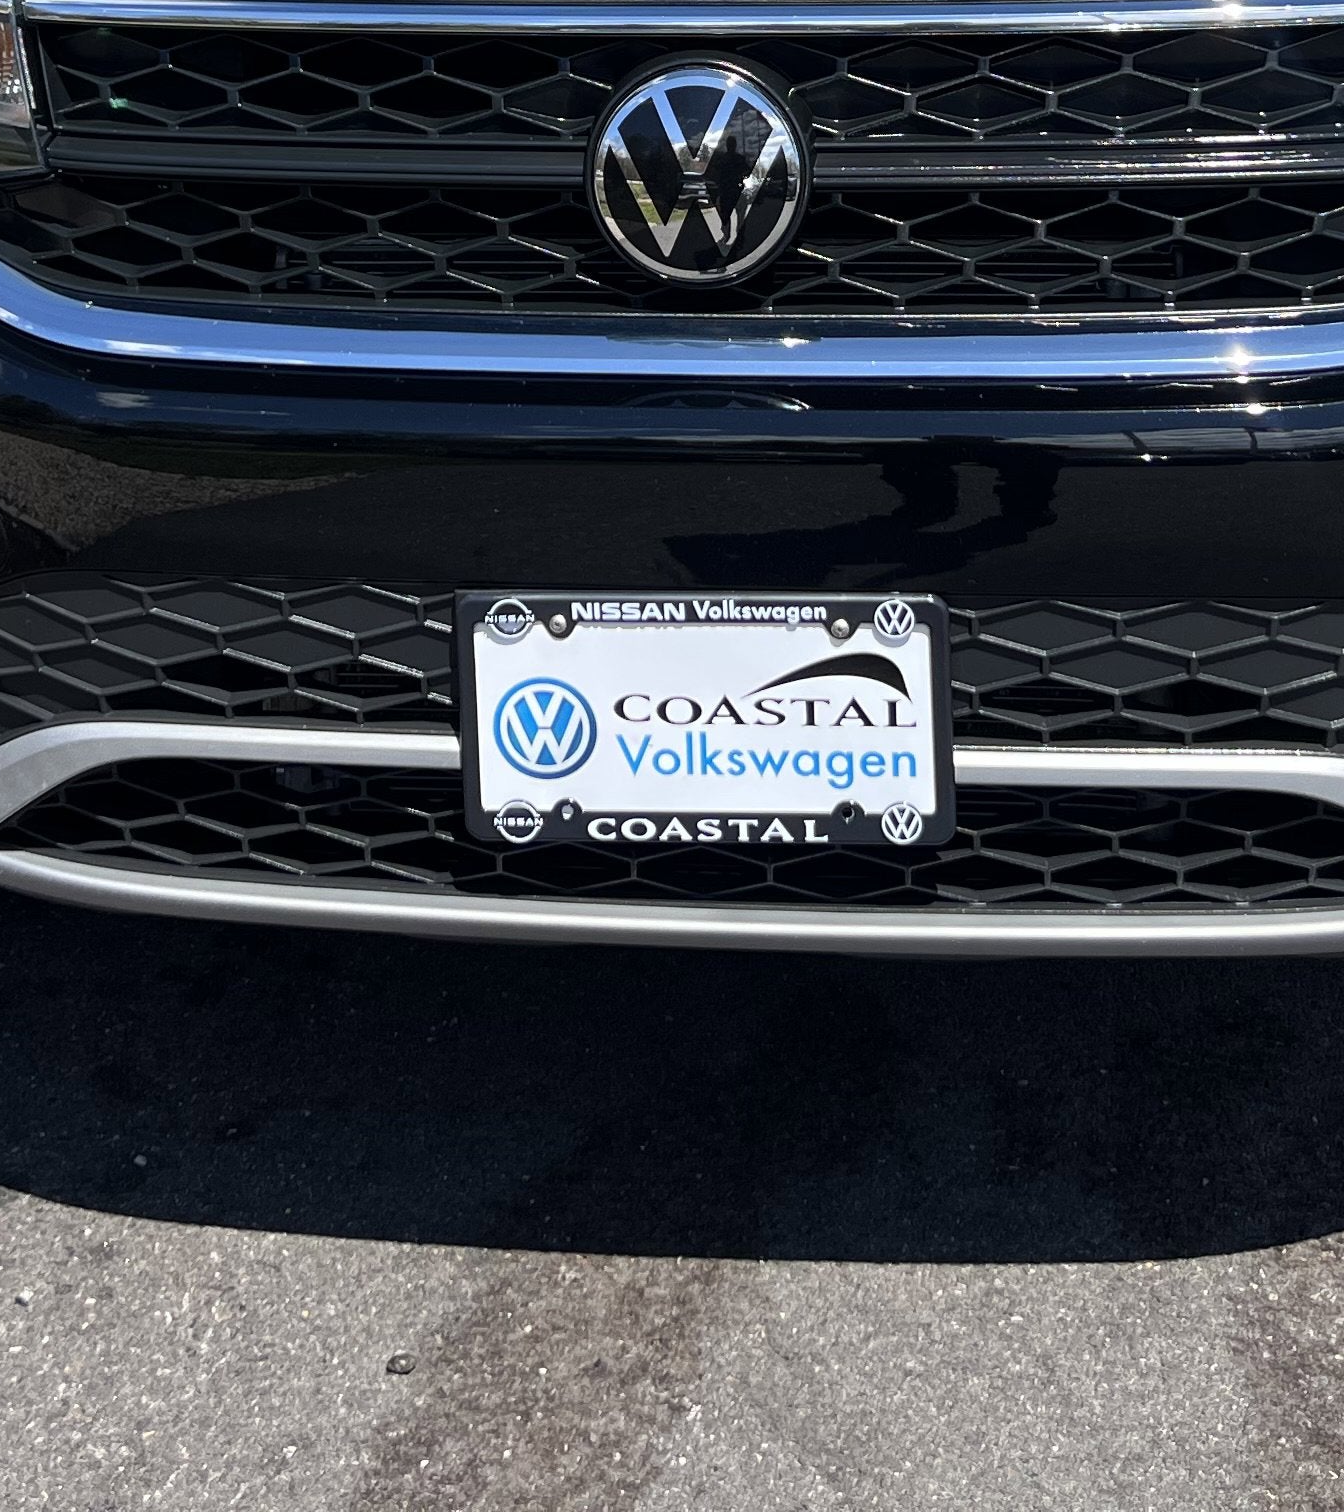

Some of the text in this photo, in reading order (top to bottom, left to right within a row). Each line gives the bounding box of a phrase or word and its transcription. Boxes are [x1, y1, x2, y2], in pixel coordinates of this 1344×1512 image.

[484, 614, 535, 625] NISSAN
[571, 599, 828, 623] NISSAN Volkswagen
[613, 694, 918, 728] COASTAL
[615, 732, 918, 789] Volkswagen
[493, 817, 544, 827] NISSAN
[586, 816, 830, 843] COASTAL
